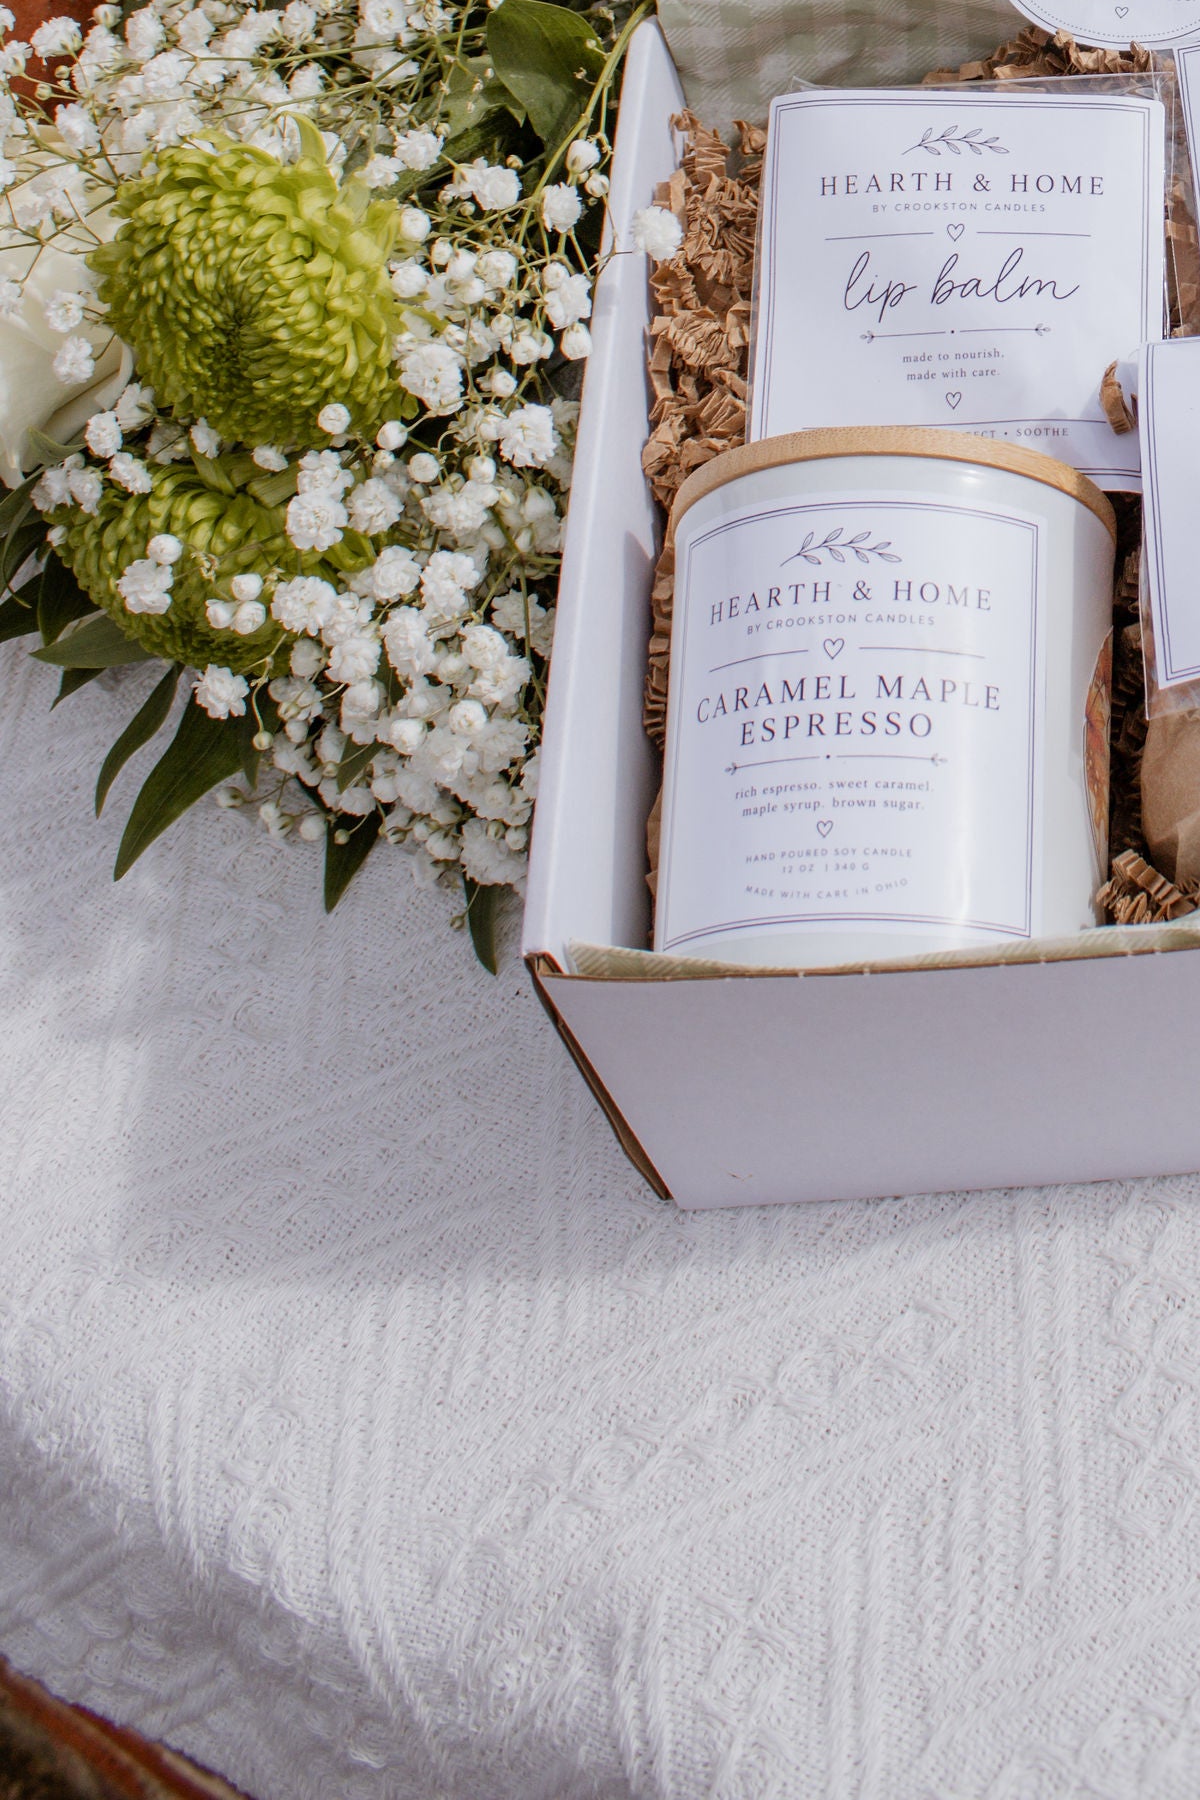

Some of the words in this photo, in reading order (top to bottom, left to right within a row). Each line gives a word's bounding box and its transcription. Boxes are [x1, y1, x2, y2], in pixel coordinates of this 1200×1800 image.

[820, 172, 953, 196] HEARTH
[973, 173, 992, 192] &
[1010, 174, 1104, 195] HOME
[872, 204, 887, 213] BY
[895, 202, 978, 212] CROOKSTON
[985, 203, 1047, 212] CANDLES
[844, 251, 917, 323] lip
[931, 247, 1080, 304] balm
[903, 352, 933, 363] made
[938, 351, 950, 361] to
[906, 370, 937, 381] made
[942, 368, 967, 379] with
[1016, 427, 1069, 437] SOOTHE
[709, 581, 832, 626] HEARTH
[852, 579, 872, 601] &
[894, 579, 992, 611] HOME
[747, 624, 761, 635] BY
[766, 613, 857, 630] CROOKSTON
[865, 613, 935, 626] CANDLES
[696, 674, 856, 723] CARAMEL
[875, 674, 1001, 711] MAPLE
[739, 711, 932, 747] ESPRESSO
[735, 784, 758, 800] rich
[828, 780, 868, 789] sweet
[742, 802, 778, 817] maple
[832, 797, 876, 808] brown
[745, 853, 776, 864] HAND
[781, 849, 829, 859] POURED
[834, 848, 857, 856] SOY
[863, 848, 913, 857] CANDLE
[782, 866, 793, 874] 12
[800, 864, 814, 872] OZ
[834, 863, 856, 871] 340
[862, 863, 870, 871] G
[745, 886, 775, 898] MADE
[780, 891, 811, 899] WITH
[816, 889, 849, 899] CARE
[855, 887, 869, 895] IN
[875, 878, 909, 892] OHIO
